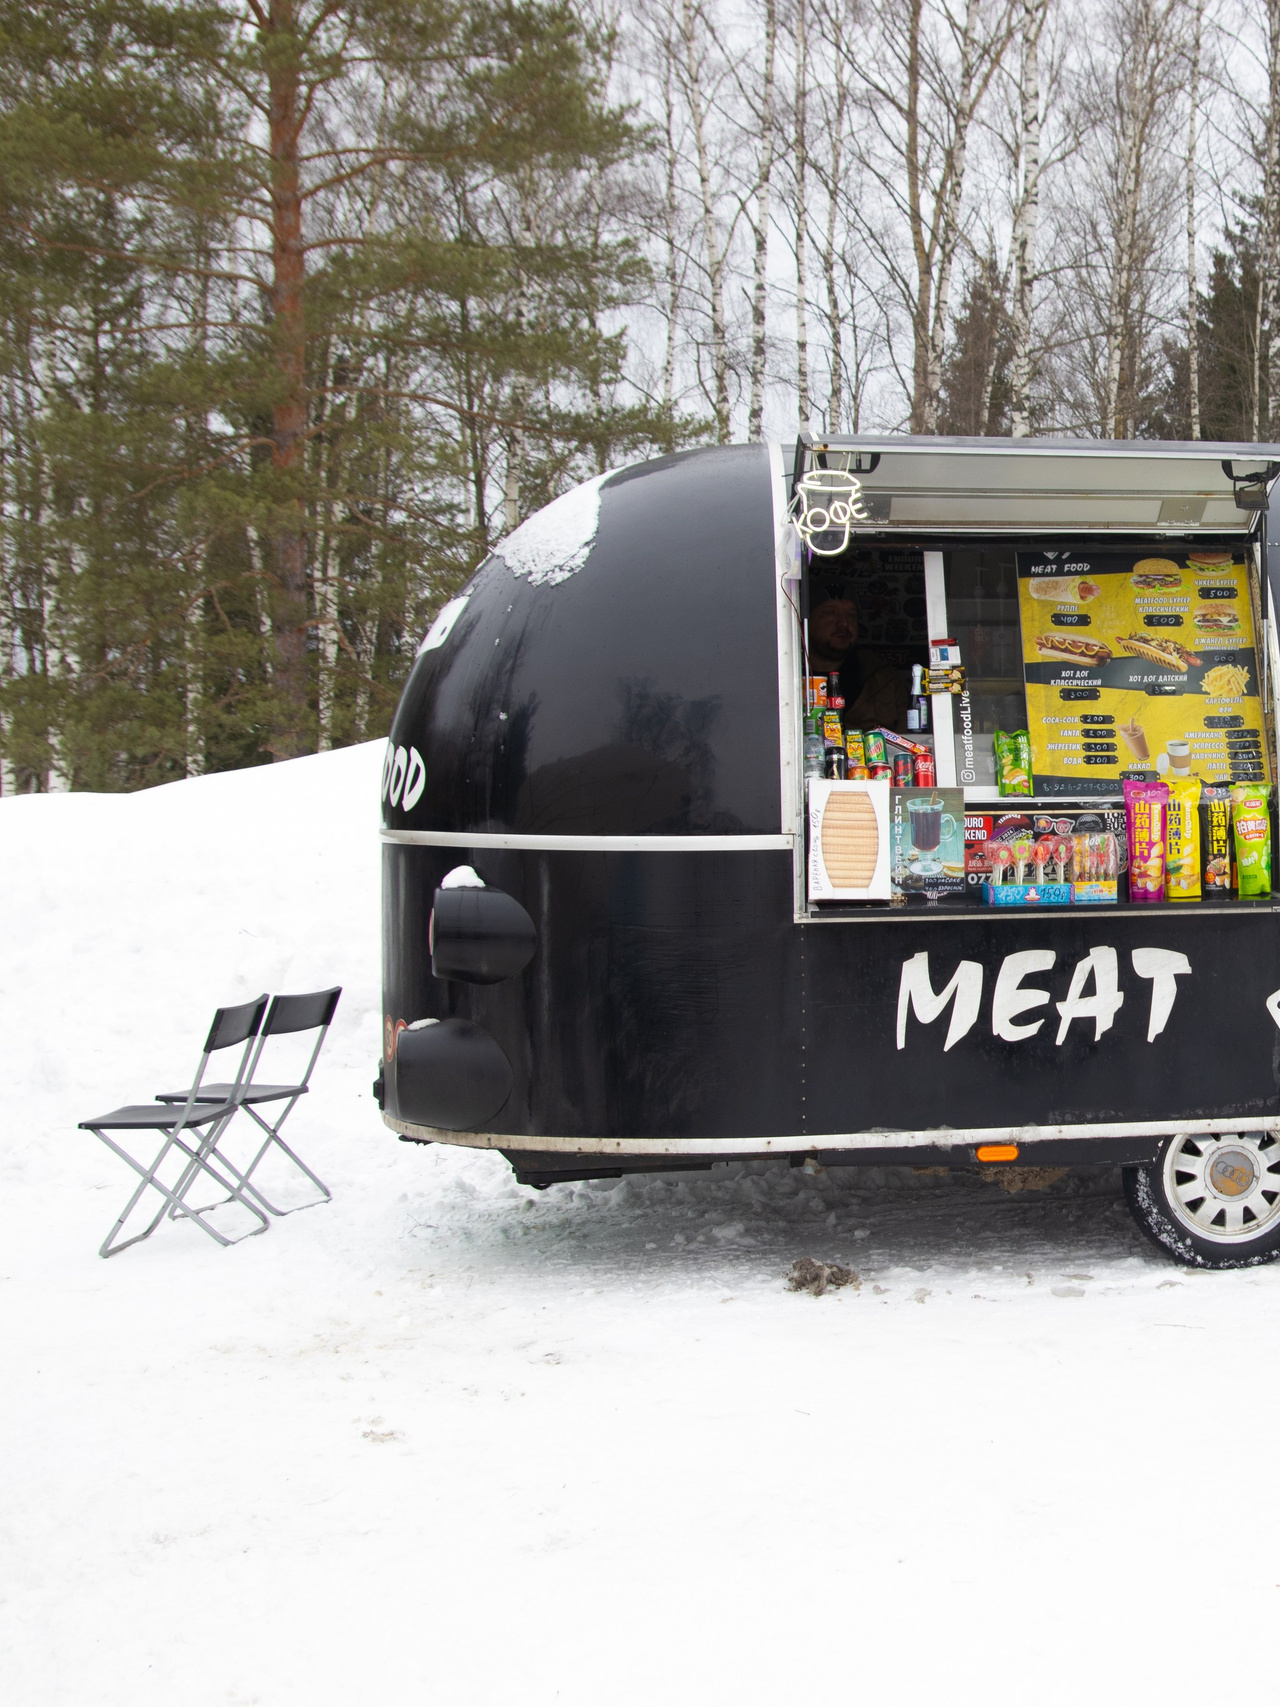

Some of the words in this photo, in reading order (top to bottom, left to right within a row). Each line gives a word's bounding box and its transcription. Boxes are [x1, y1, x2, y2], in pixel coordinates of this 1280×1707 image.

[791, 491, 869, 539] КОФЕ
[1030, 564, 1058, 575] MEAT
[1063, 562, 1091, 573] FOOD
[1209, 590, 1230, 598] 500
[1138, 605, 1189, 613] КЛАССИЧЕСКИЙ
[1060, 615, 1079, 623] 400
[1194, 637, 1224, 645] ДЖАНГЛ
[1225, 637, 1247, 645] БУРГЕР
[1060, 670, 1074, 678] ХОТ
[1075, 670, 1089, 678] ДОГ
[1128, 674, 1142, 683] ХОТ
[1143, 674, 1157, 683] ДОГ
[1157, 673, 1188, 683] ДАТСКИЙ
[1050, 678, 1102, 687] КЛАССИЧЕСКИЙ
[1070, 691, 1089, 699] 300
[1205, 696, 1244, 704] КАРТОФЕЛЬ
[1042, 716, 1079, 724] COCA-COLA
[959, 689, 974, 769] meatfoodLive
[1060, 729, 1080, 737] FANTA
[1184, 731, 1223, 739] АМЕРИКАНО
[1046, 743, 1081, 751] ЭНЕРГЕТИК
[1090, 743, 1108, 751] 300
[1090, 756, 1108, 764] 200
[1191, 752, 1226, 760] КАПУЧИНО
[1063, 756, 1082, 765] ВОДА
[1206, 762, 1227, 770] ЛАТТЕ
[1128, 774, 1145, 782] 300
[964, 817, 983, 831] DURO
[1167, 798, 1182, 855] 山药薄片
[1210, 798, 1226, 855] 山药薄片
[1134, 800, 1150, 857] 山药薄片
[965, 830, 987, 841] KEND
[896, 944, 1194, 1053] MEAT
